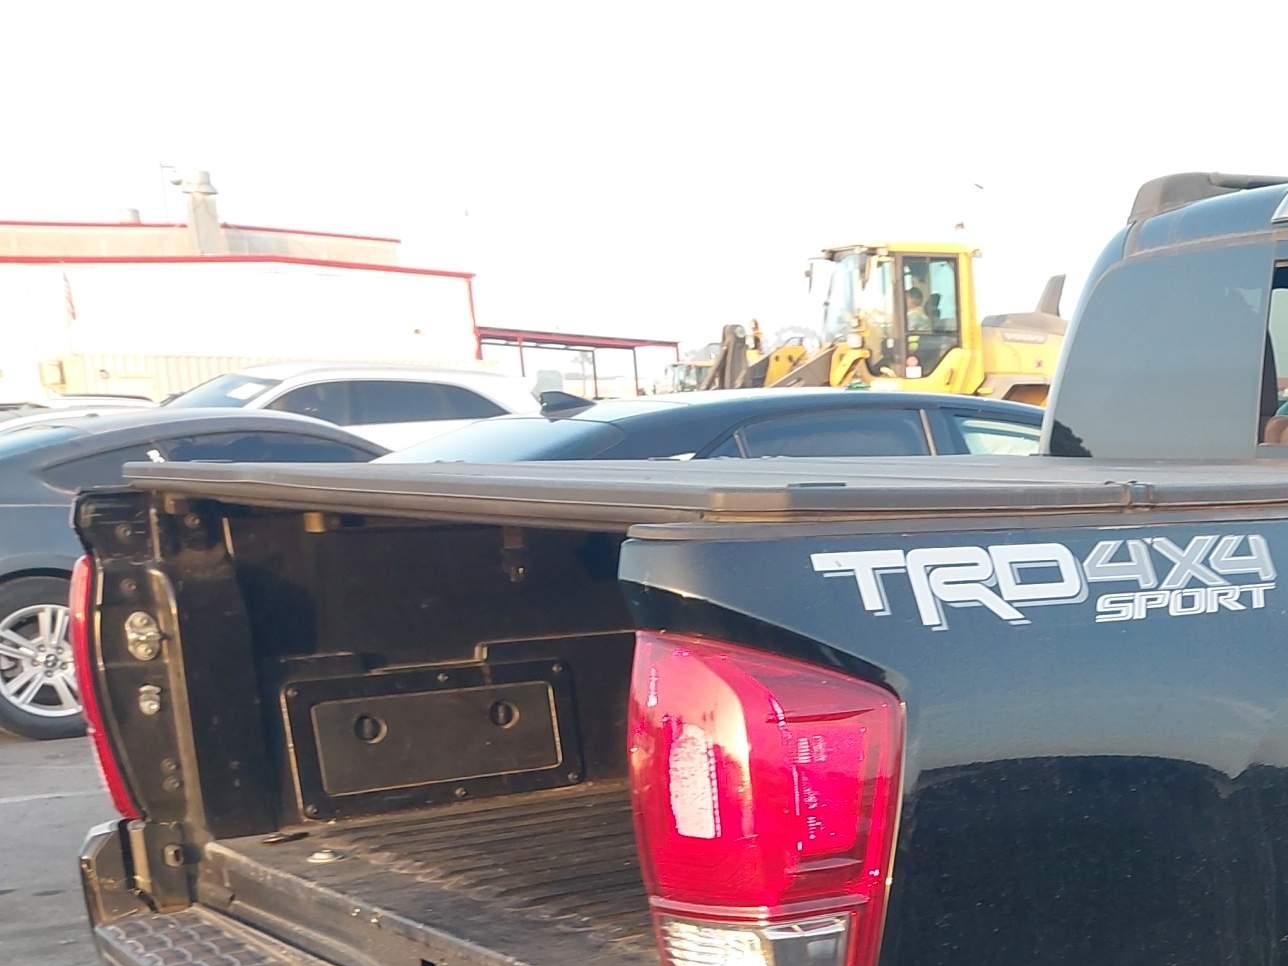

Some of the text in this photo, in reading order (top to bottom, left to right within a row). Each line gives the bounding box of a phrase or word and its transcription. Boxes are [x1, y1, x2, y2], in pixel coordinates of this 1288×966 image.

[810, 534, 1277, 631] TRD 4X4
[1096, 582, 1277, 623] SPORT
